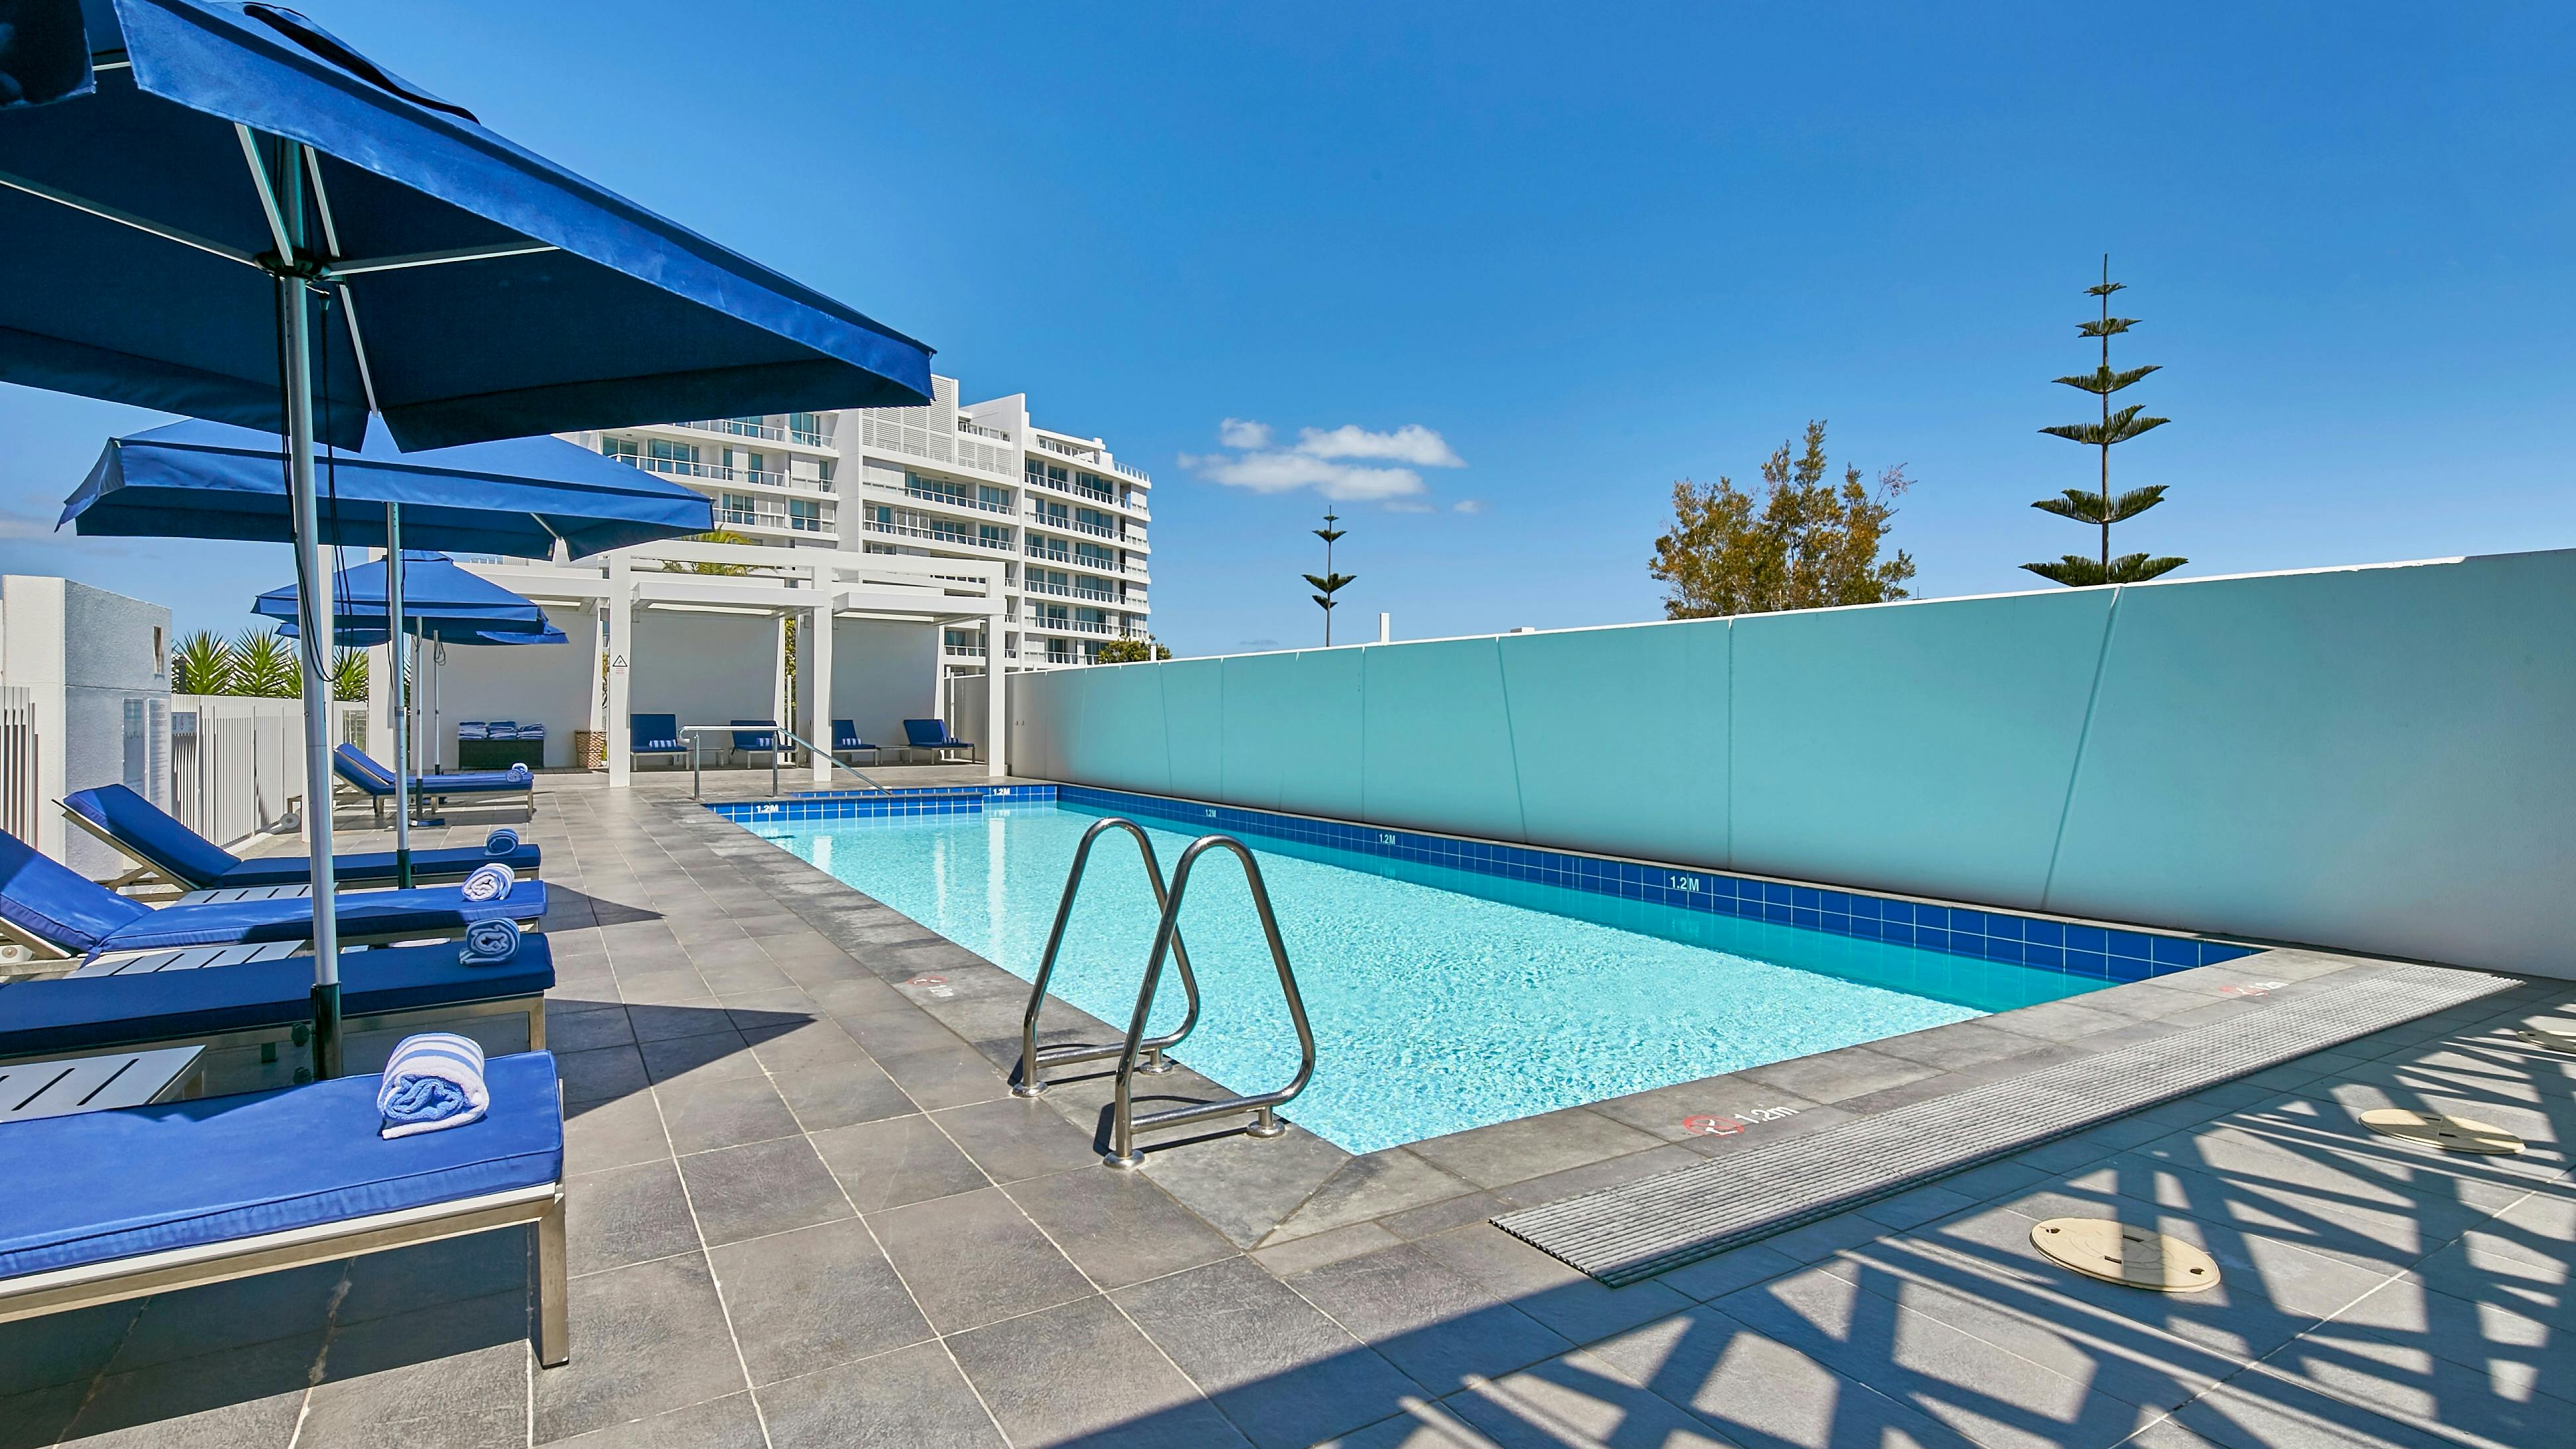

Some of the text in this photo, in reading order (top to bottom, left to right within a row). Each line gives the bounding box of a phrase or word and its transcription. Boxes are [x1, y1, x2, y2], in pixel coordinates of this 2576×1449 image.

[756, 804, 778, 813] 1.2M
[1379, 833, 1395, 845] 1.2M
[1670, 875, 1699, 891] 1.2M
[1735, 1106, 1800, 1124] 1.2m
